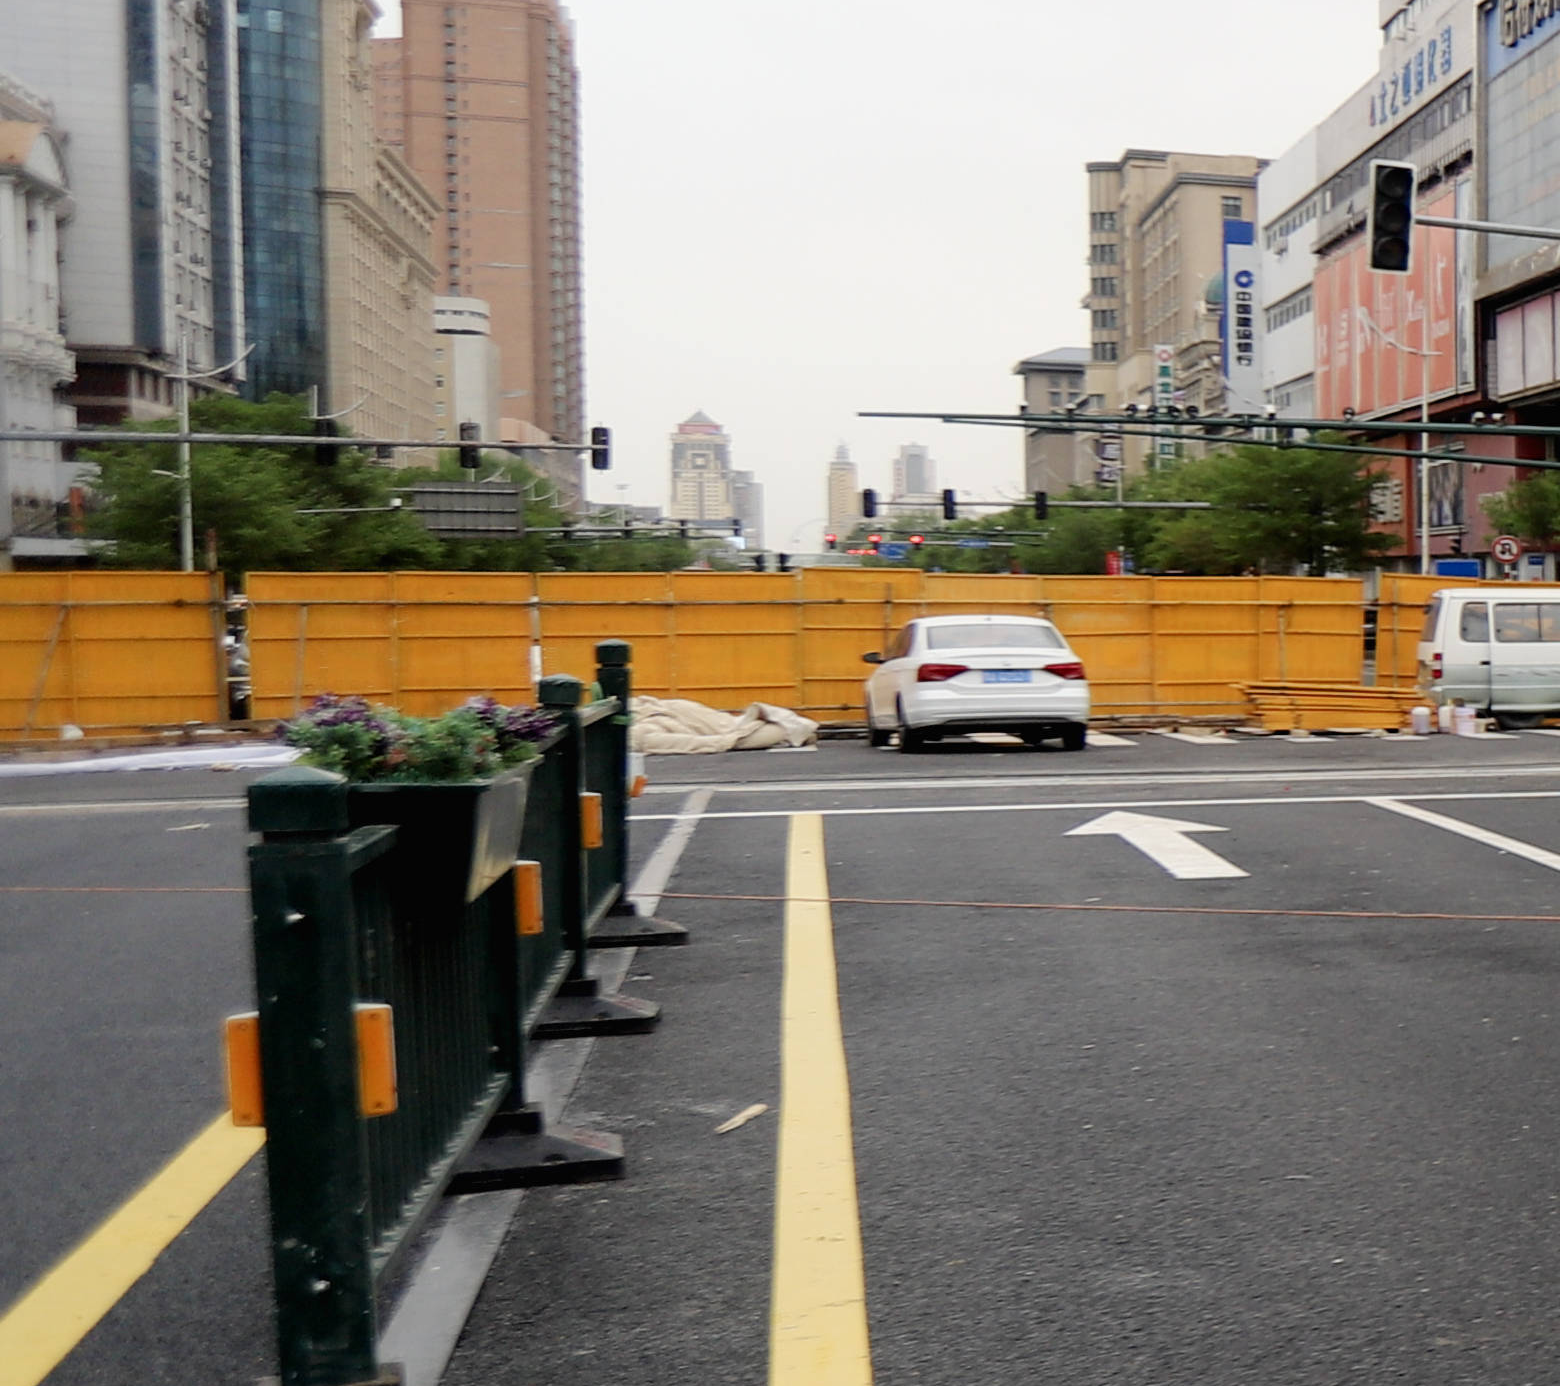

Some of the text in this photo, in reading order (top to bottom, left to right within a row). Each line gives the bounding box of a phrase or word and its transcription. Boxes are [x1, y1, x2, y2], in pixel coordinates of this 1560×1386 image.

[1235, 291, 1253, 367] 中国建设银行
